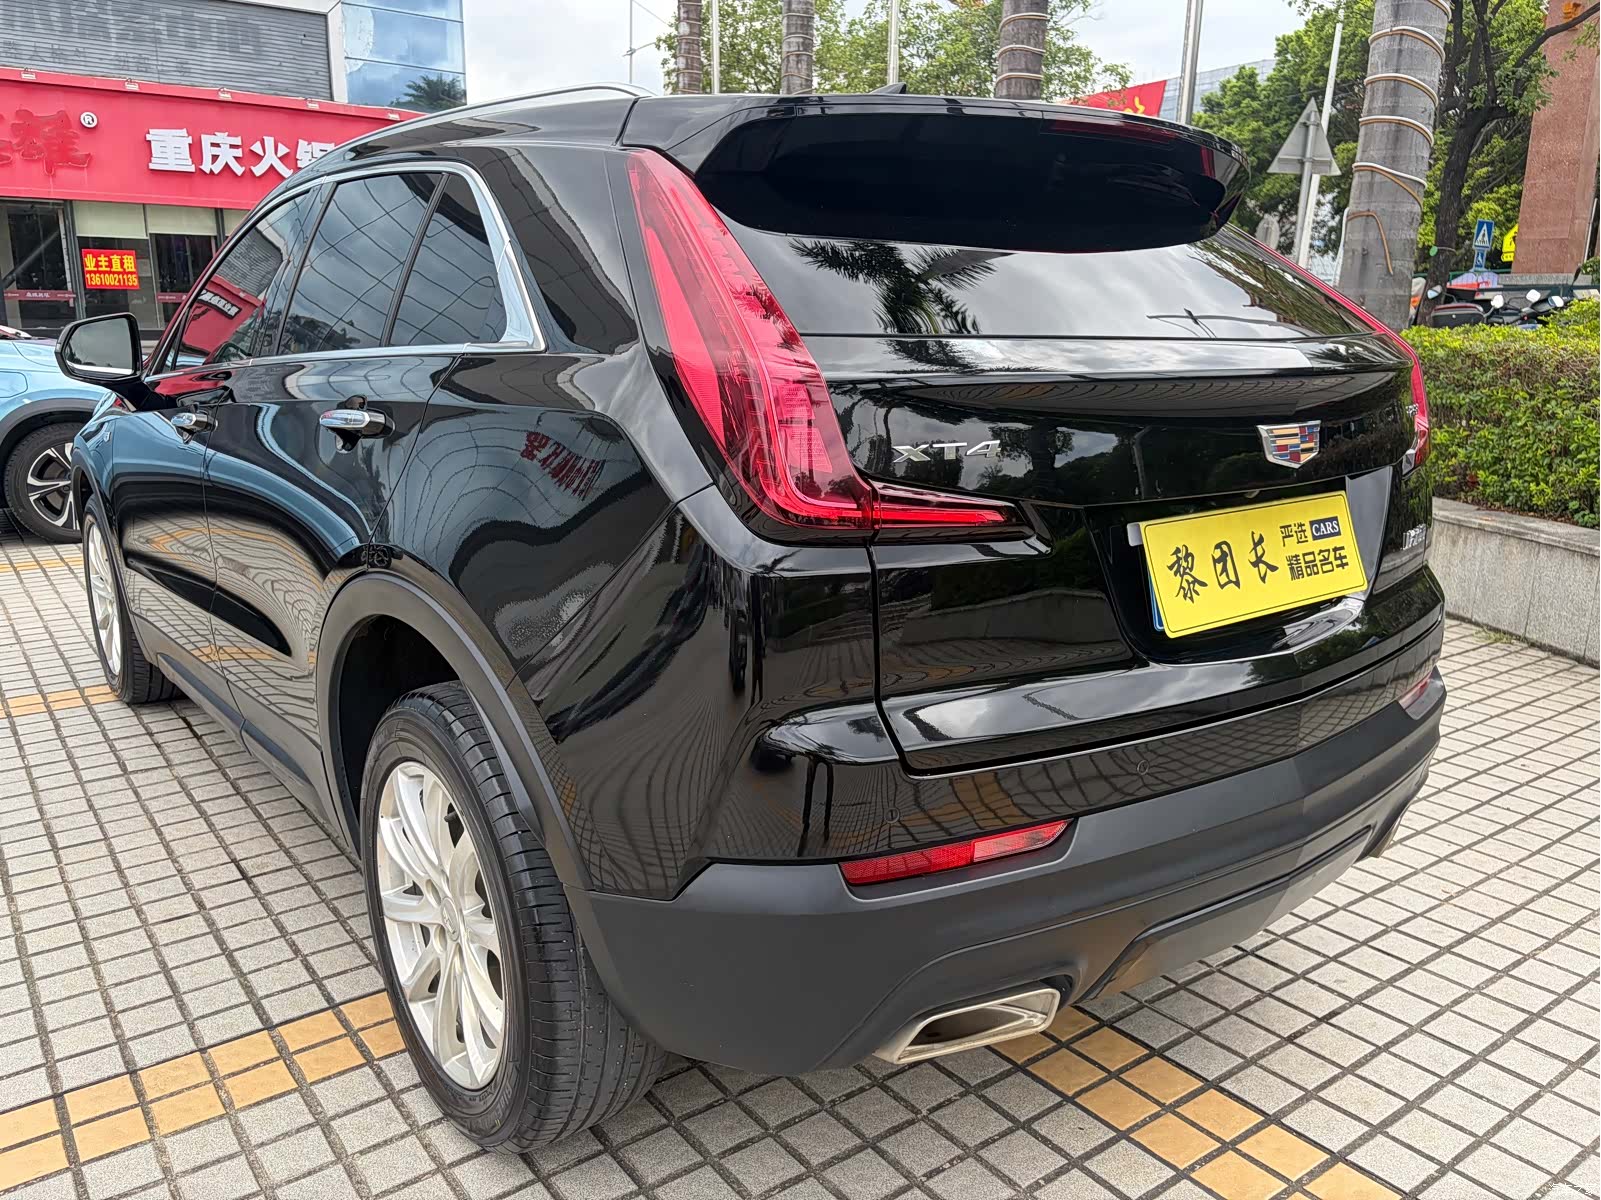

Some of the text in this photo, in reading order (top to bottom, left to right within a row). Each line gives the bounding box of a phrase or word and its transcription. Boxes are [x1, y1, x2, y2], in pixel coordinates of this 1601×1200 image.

[84, 253, 137, 272] 业主直租
[86, 273, 138, 286] 13610021135
[892, 439, 1002, 463] XT4
[1279, 518, 1340, 548] 严选 CARS
[1166, 530, 1280, 604] 黎团长
[1285, 545, 1350, 581] 精品名车
